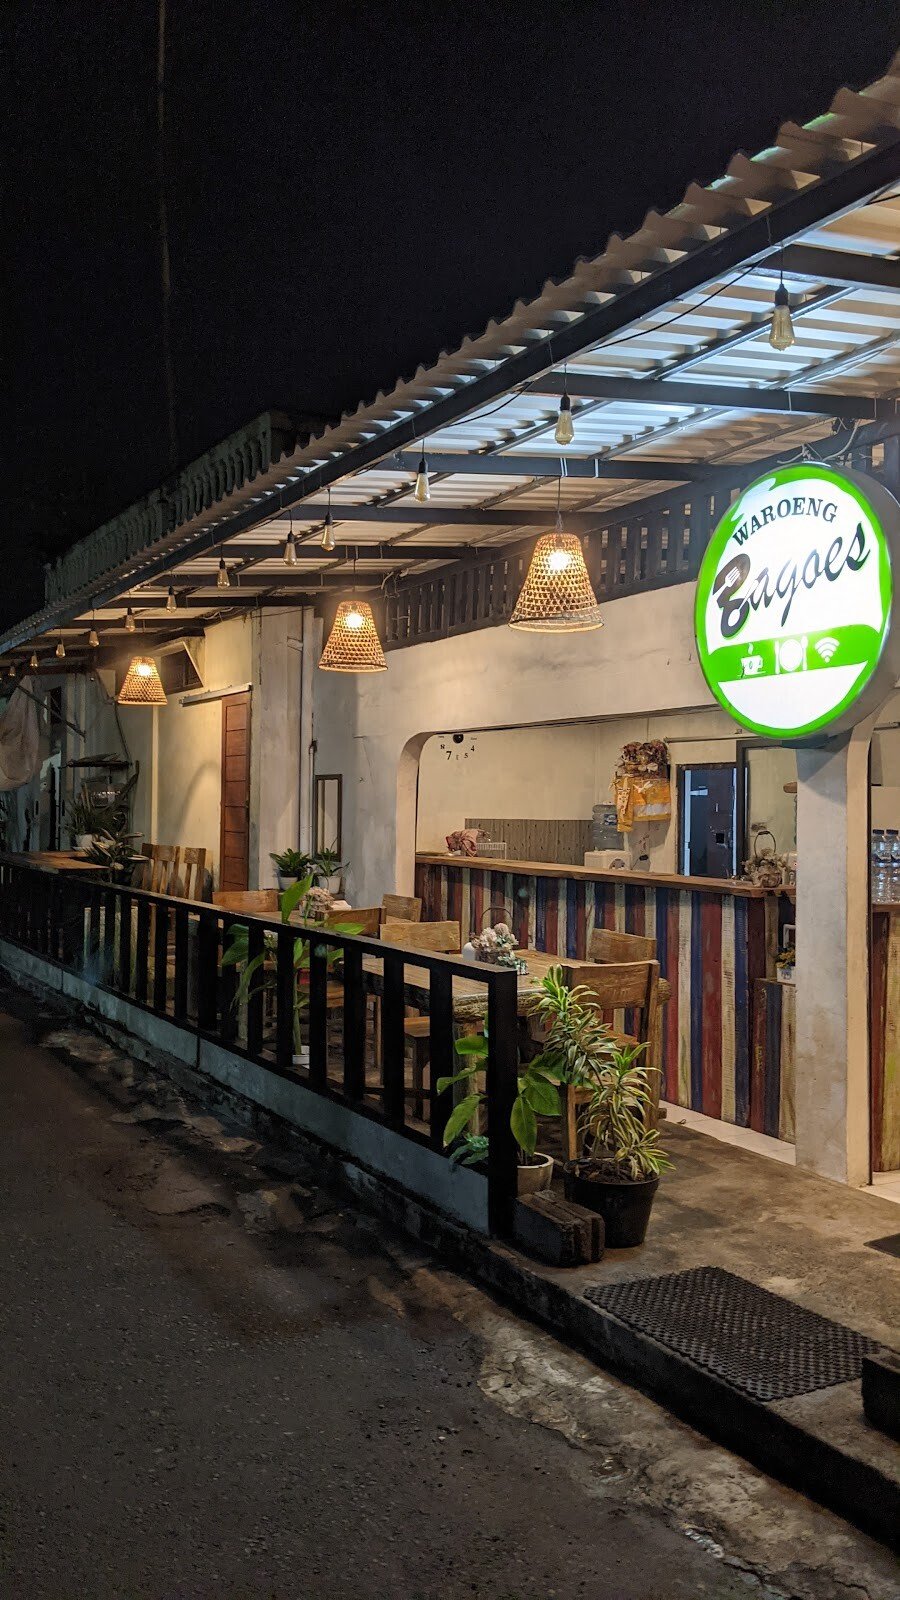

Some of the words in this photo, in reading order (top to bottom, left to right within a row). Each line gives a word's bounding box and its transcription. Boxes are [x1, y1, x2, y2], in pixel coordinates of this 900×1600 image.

[732, 497, 837, 546] WAROENG
[713, 522, 870, 638] Bagoes
[446, 750, 452, 760] 7
